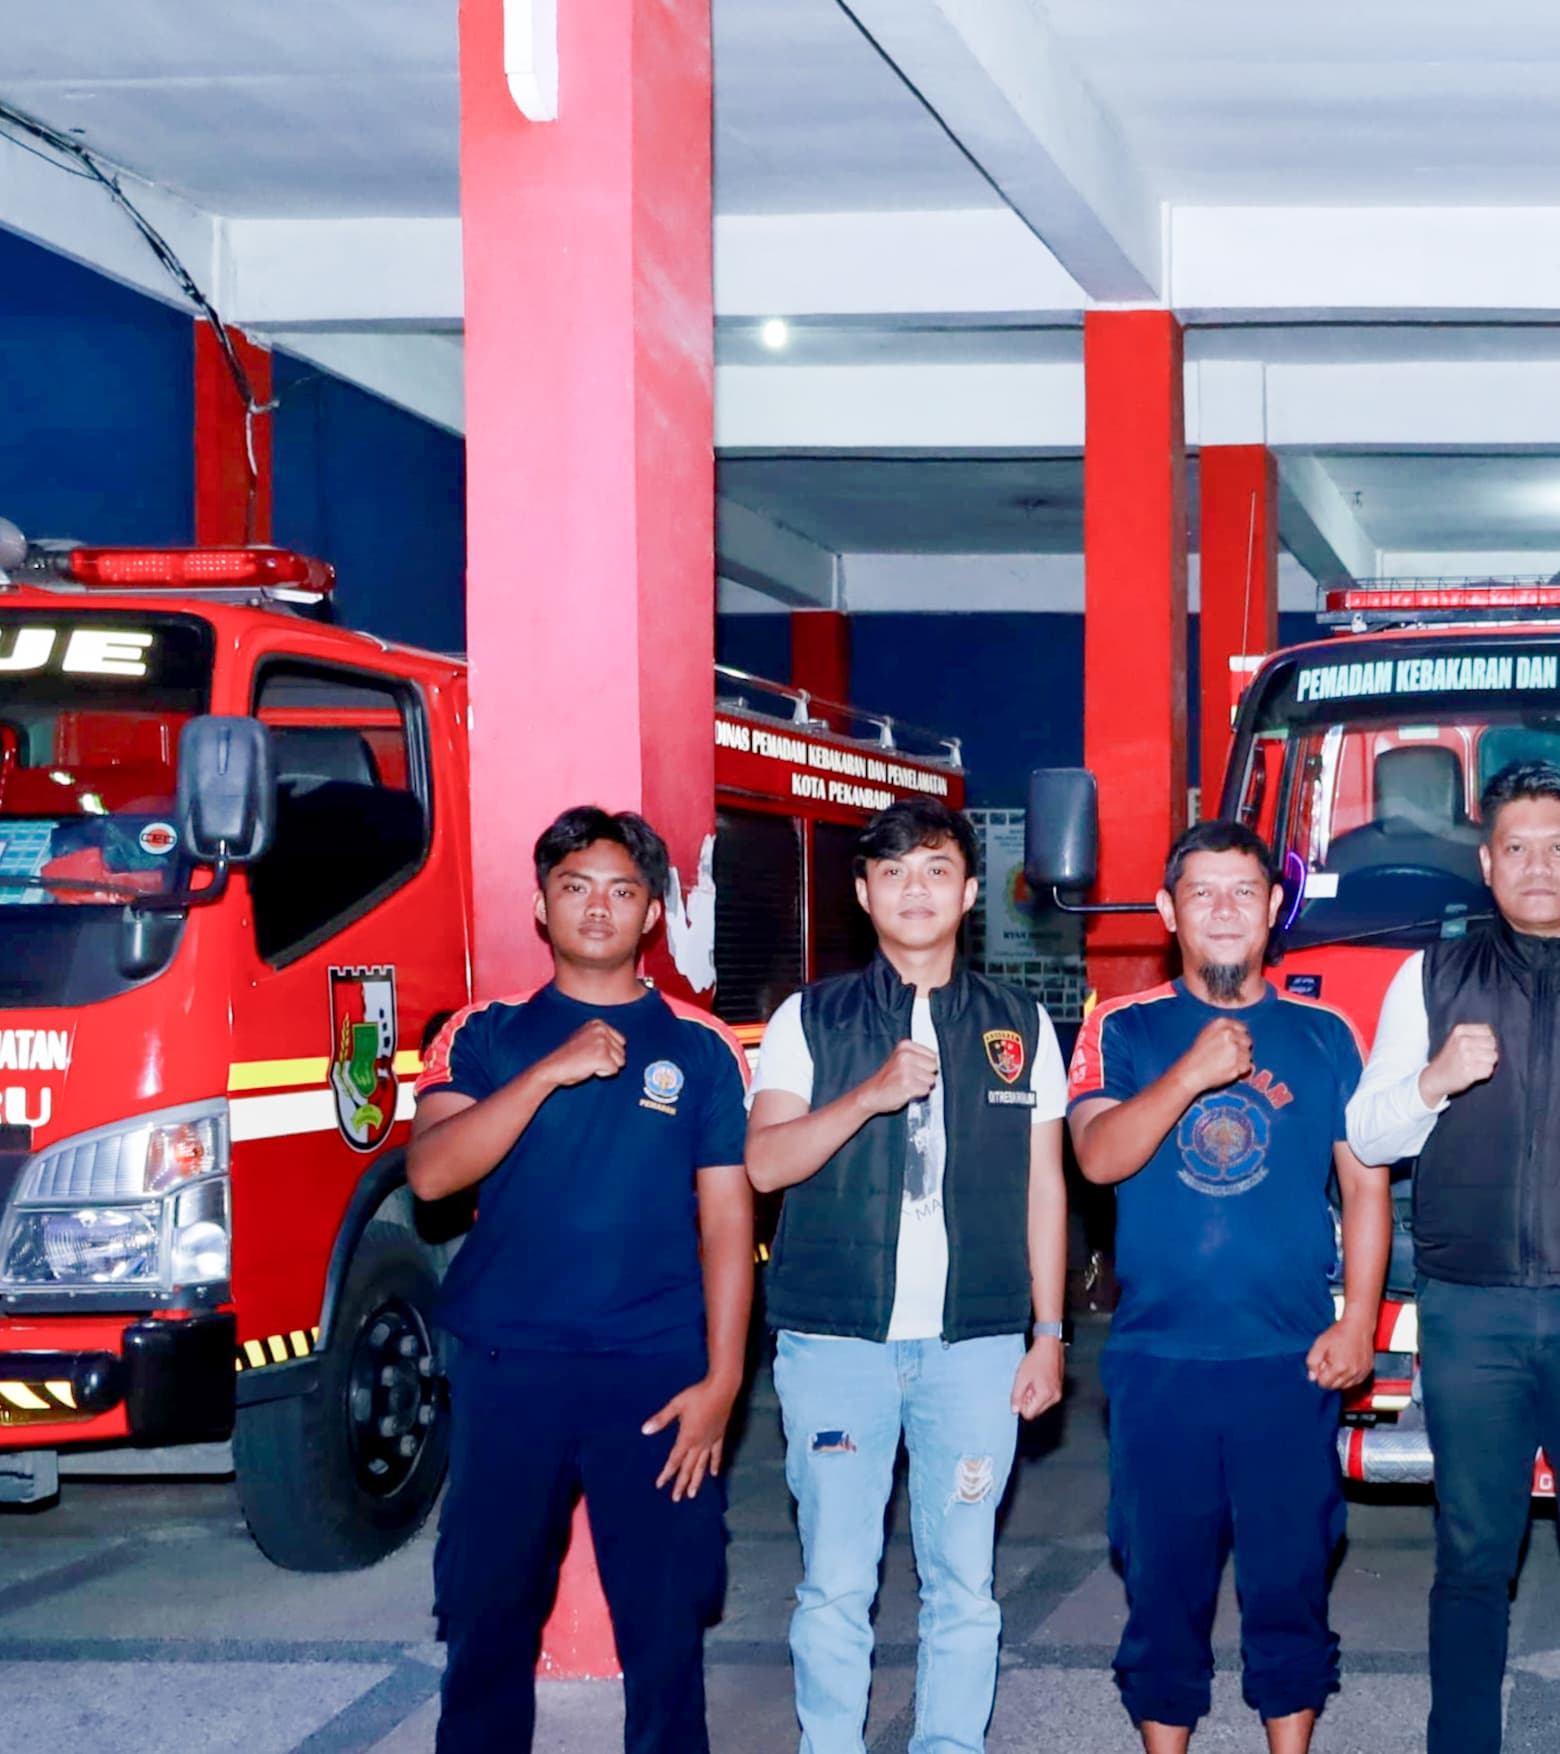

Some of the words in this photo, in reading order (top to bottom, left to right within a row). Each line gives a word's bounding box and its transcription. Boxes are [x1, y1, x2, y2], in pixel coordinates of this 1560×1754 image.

[1297, 661, 1393, 701] PEMADAM
[1396, 657, 1512, 692] KEBAKARAN
[1516, 656, 1556, 689] DAN
[715, 720, 750, 751] DINAS
[752, 729, 807, 764] PEMADAM
[808, 743, 866, 778] KEBAKARAN
[867, 758, 886, 783] DAN
[888, 763, 948, 796] PENYELAMATAN
[792, 772, 826, 800] KOTA
[0, 1029, 68, 1070] ATAN
